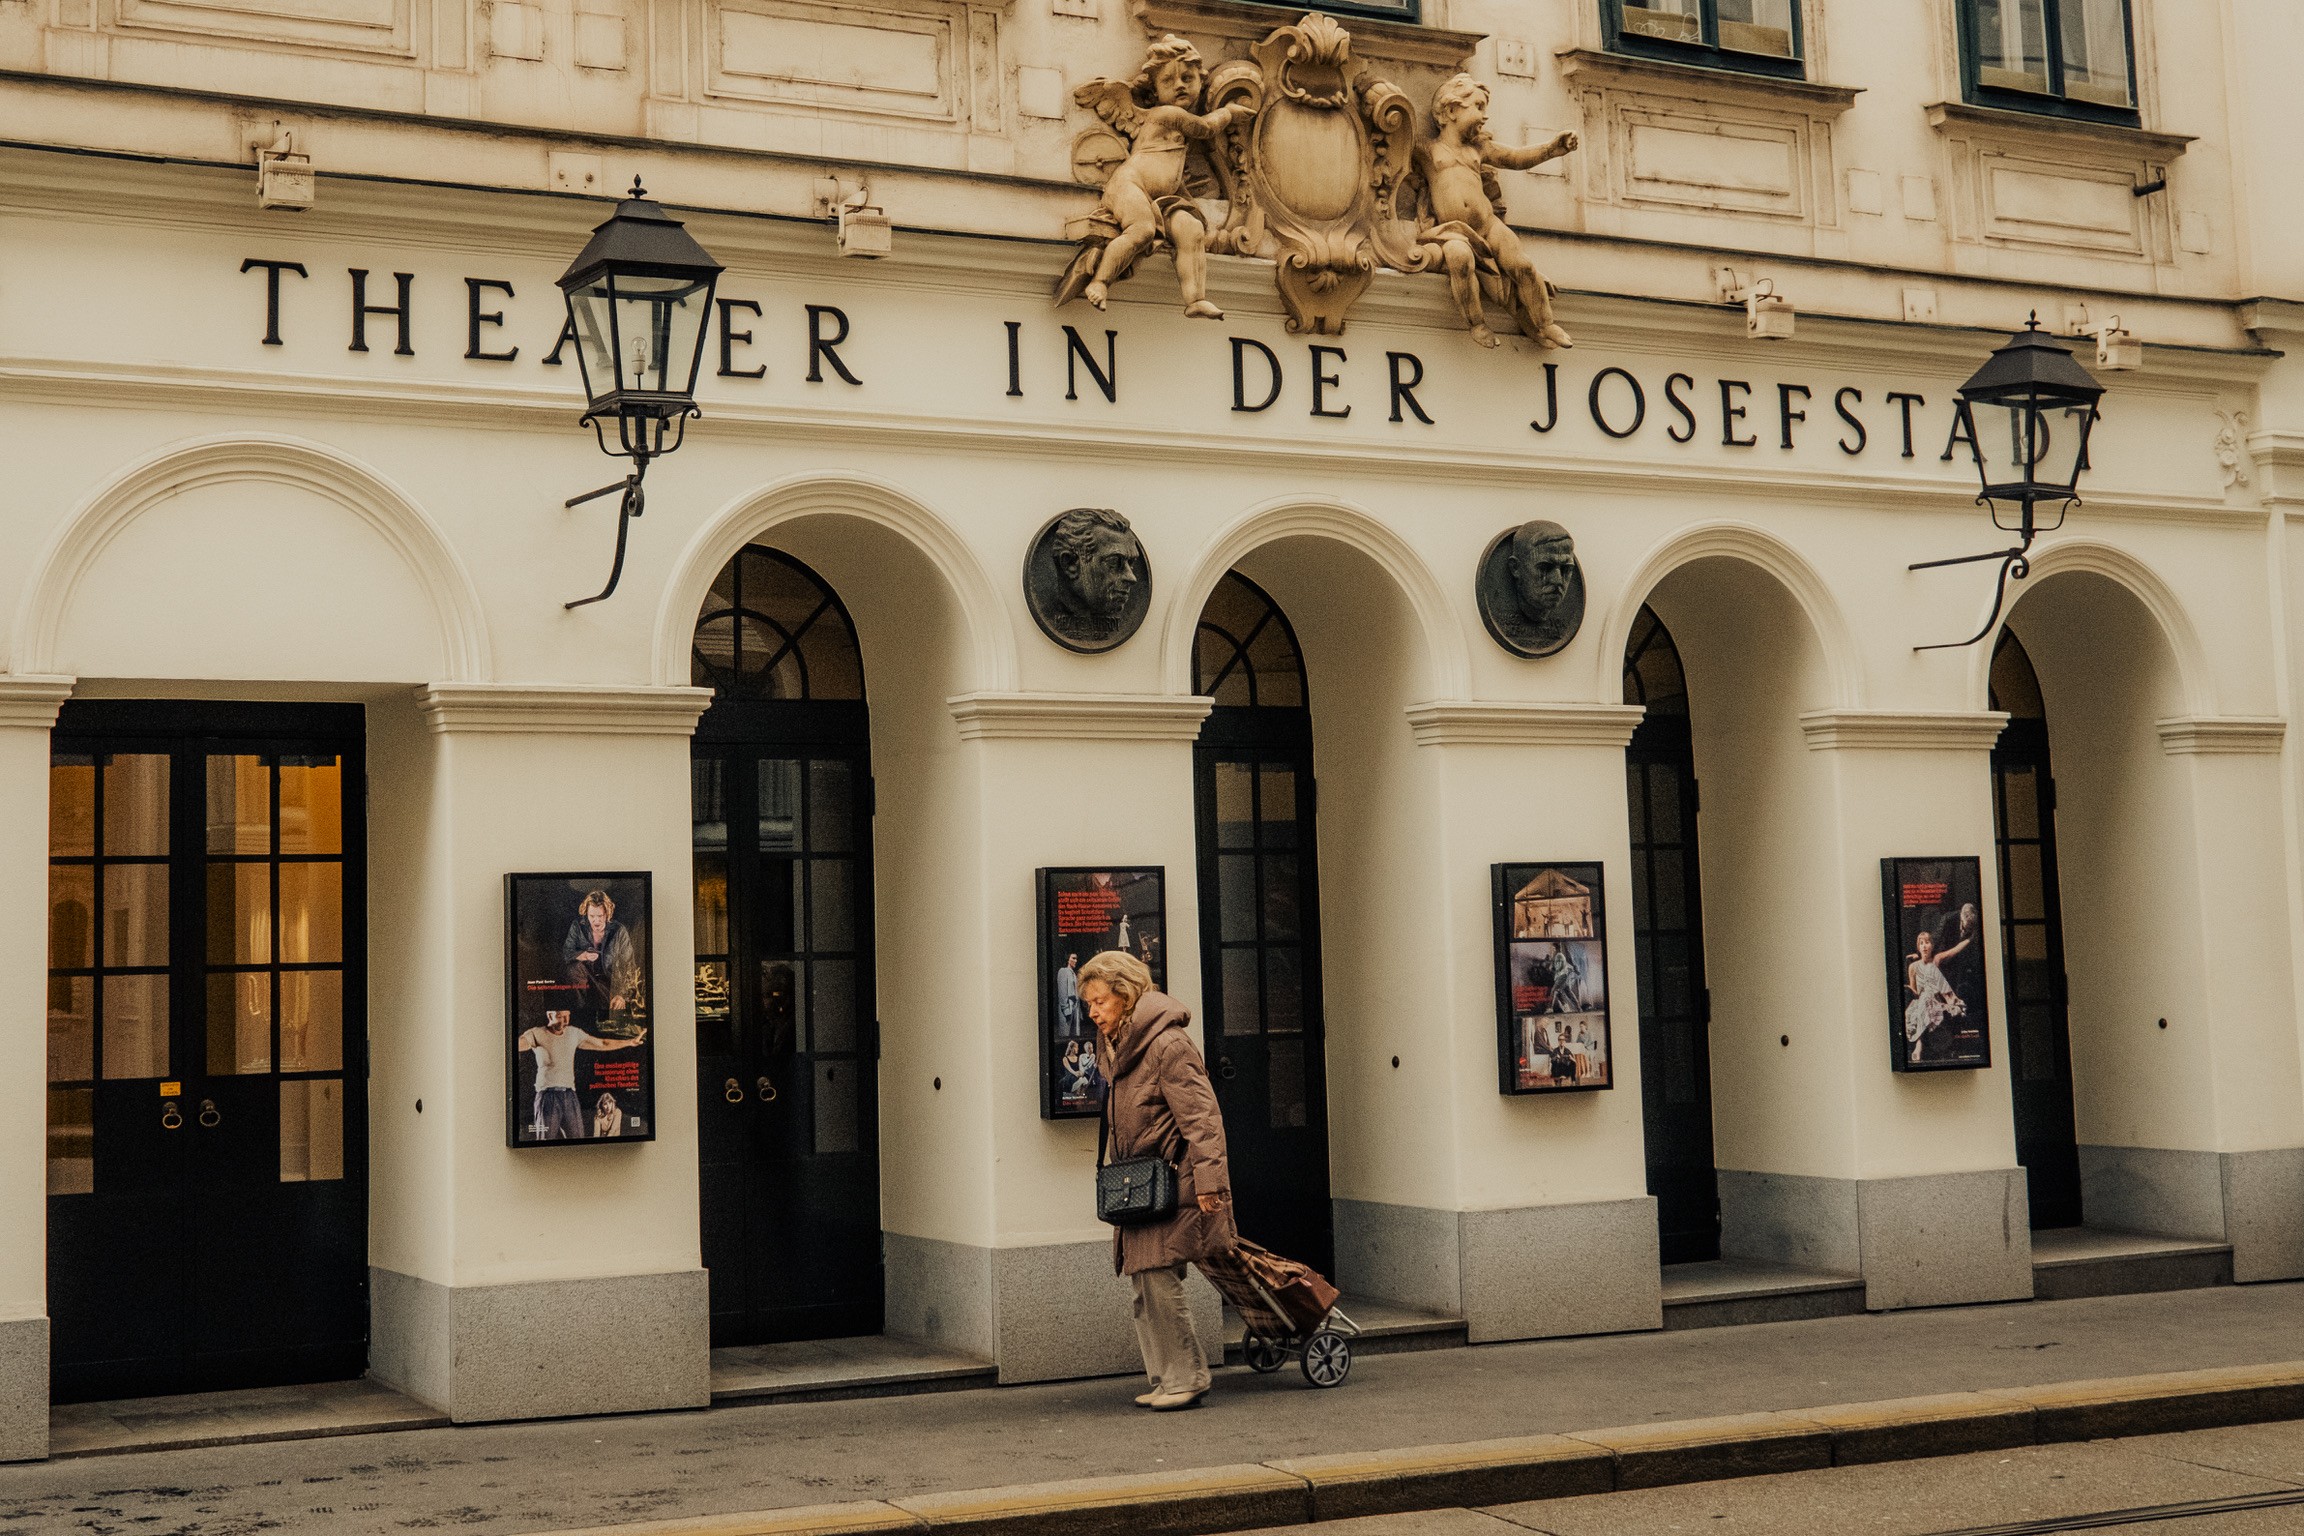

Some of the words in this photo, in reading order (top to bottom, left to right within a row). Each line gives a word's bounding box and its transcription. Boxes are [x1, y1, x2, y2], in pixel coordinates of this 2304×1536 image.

[239, 257, 864, 386] THEATER
[1003, 321, 1119, 404] IN
[1228, 336, 1436, 425] DER
[1529, 362, 2102, 471] JOSEFSTADT
